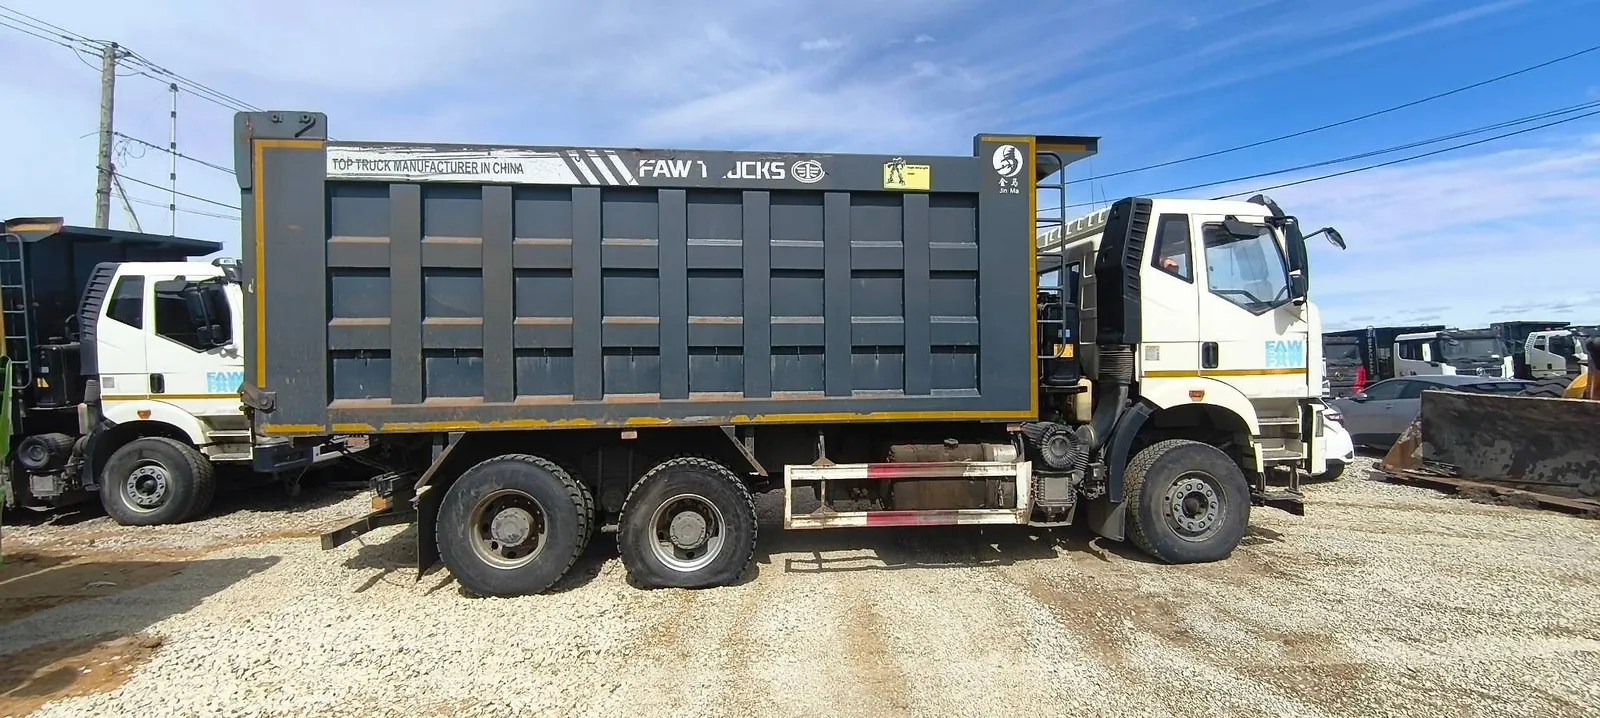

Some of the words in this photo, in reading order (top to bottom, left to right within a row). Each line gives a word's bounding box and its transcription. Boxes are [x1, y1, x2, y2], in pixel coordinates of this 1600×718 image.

[332, 158, 353, 170] TOP
[355, 158, 391, 171] TRUCK
[394, 160, 479, 174] MANUFACTURER
[480, 161, 491, 174] IN
[492, 162, 524, 174] CHINA
[638, 160, 693, 178] FAW
